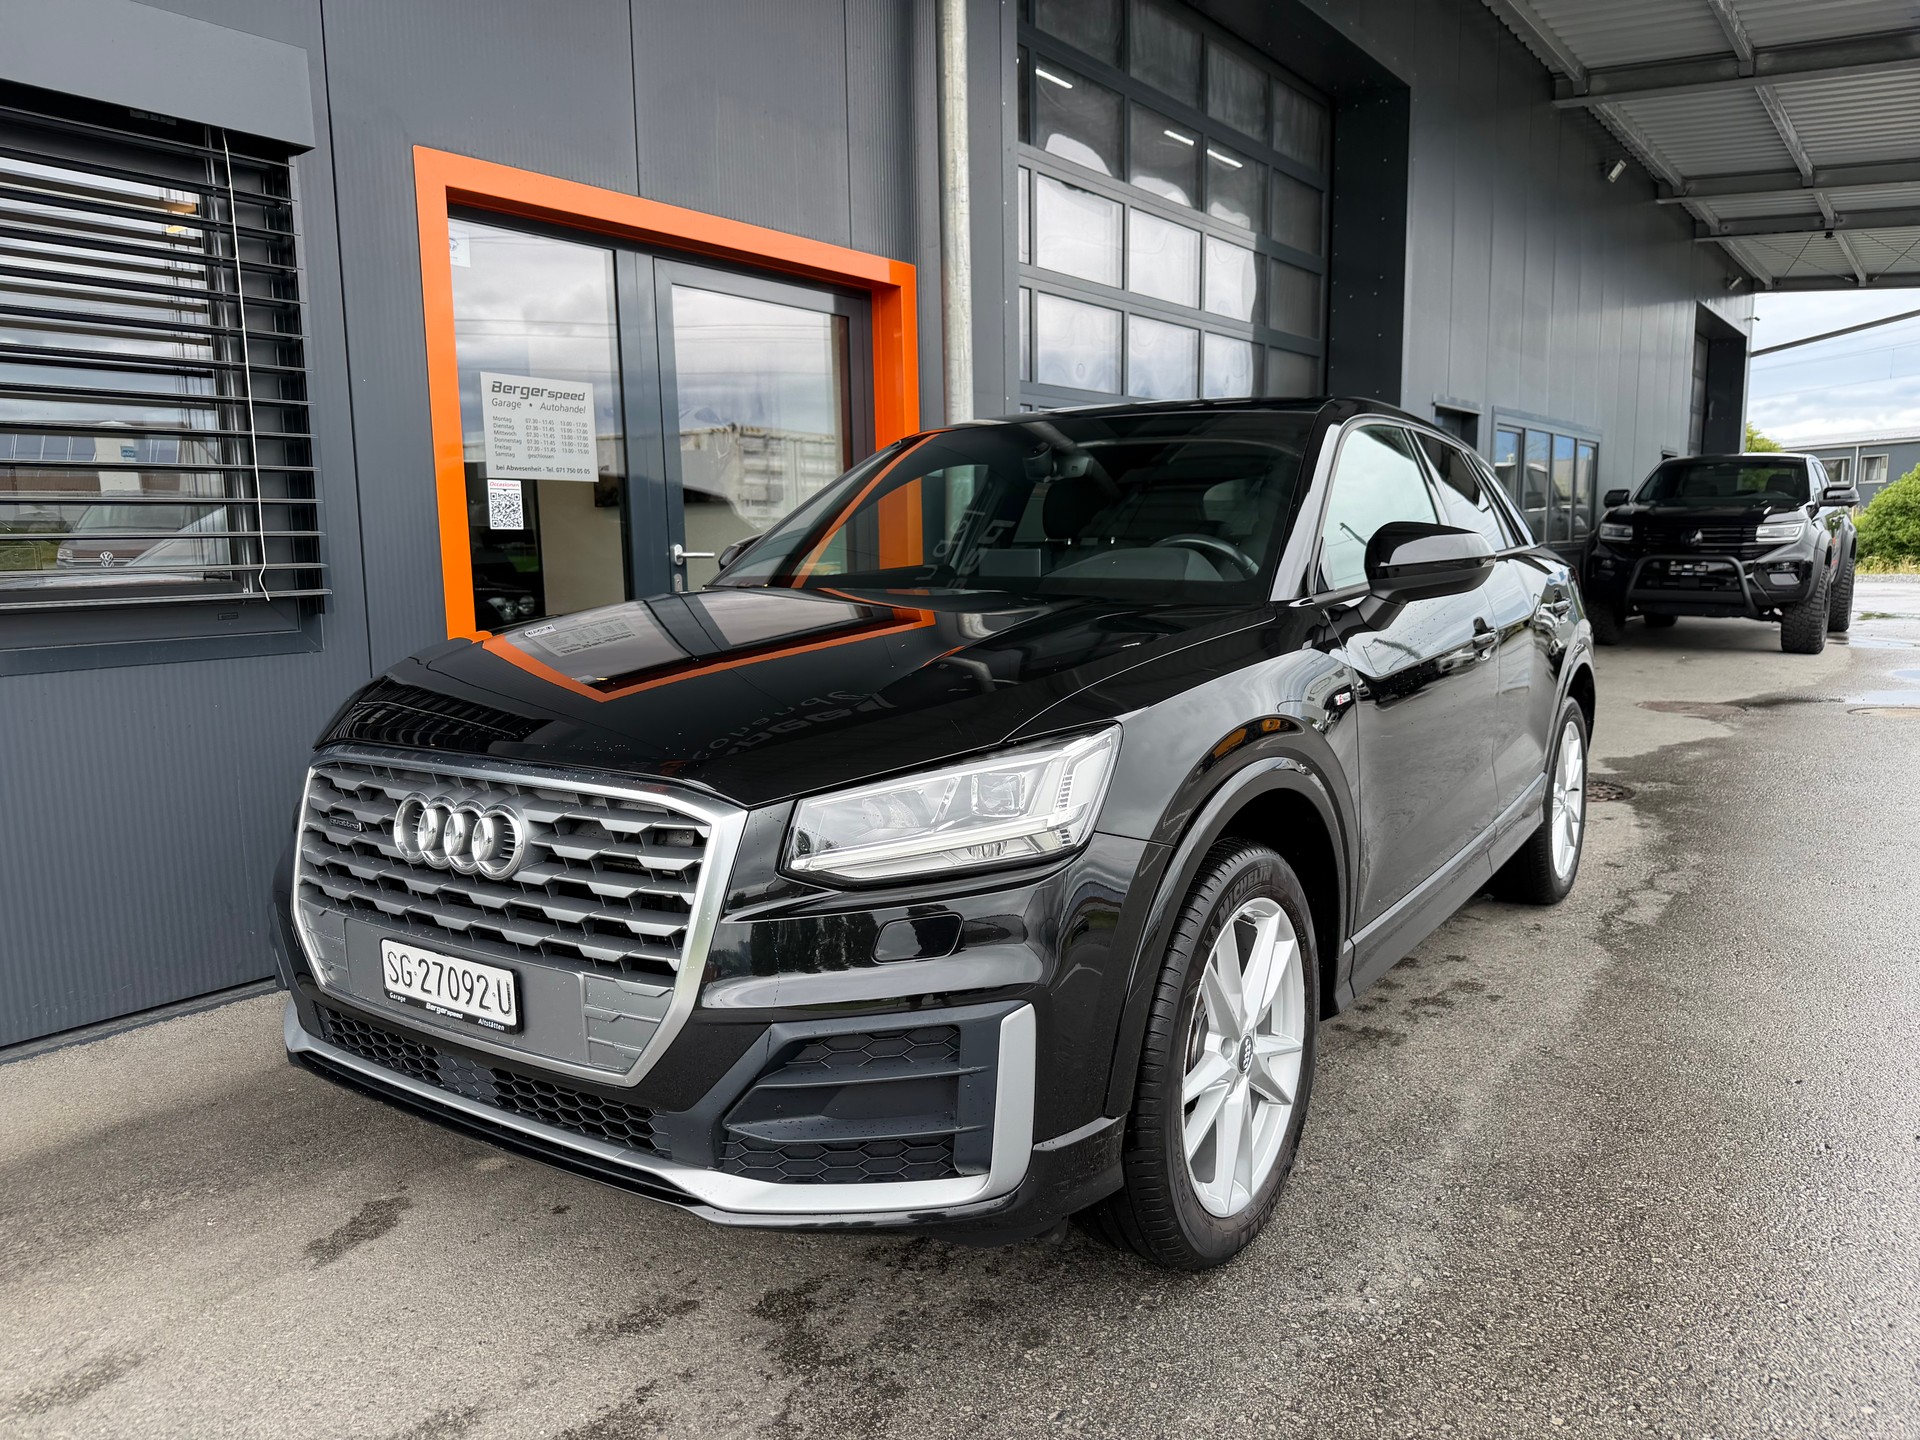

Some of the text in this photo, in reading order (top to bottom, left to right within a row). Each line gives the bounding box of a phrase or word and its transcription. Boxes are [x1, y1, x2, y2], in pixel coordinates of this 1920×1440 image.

[491, 380, 586, 401] Bergerspeed
[491, 398, 587, 415] Garage Autohandel
[492, 415, 512, 424] Montag
[493, 422, 515, 431] Dienstag
[495, 443, 512, 452] Freitag
[495, 450, 516, 459] Samstag
[506, 465, 542, 473] Abwesenheit
[1218, 864, 1273, 926] MICHELIN
[389, 992, 505, 1031] Garage Bergerspeed Altstätten
